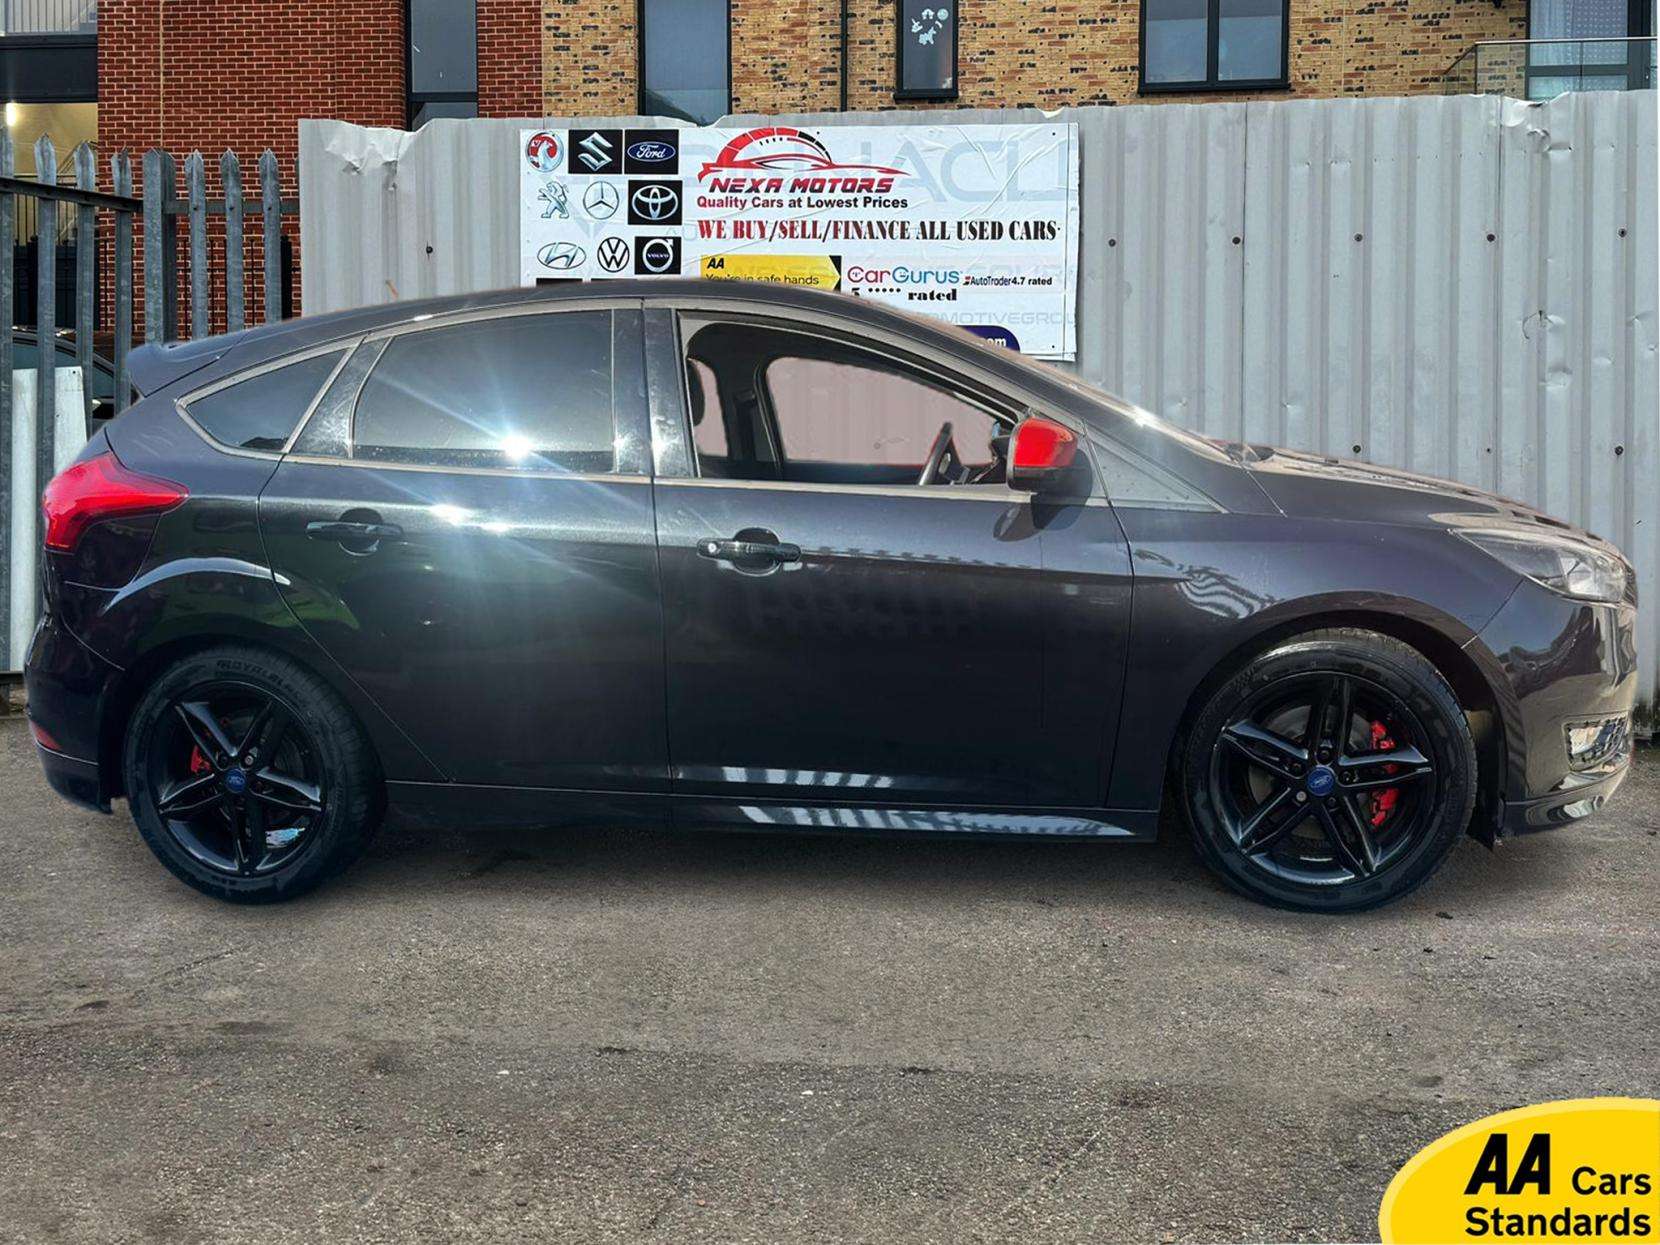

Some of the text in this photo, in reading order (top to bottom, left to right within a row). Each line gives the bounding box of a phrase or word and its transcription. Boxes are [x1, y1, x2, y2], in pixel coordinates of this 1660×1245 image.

[636, 143, 666, 159] Ford
[708, 177, 895, 194] NEXA MOTORS
[697, 195, 909, 211] Quality Cars at Lowest Prices
[698, 220, 727, 240] WE
[915, 220, 951, 240] ALL
[956, 220, 1004, 240] USED
[1008, 220, 1057, 240] CARS
[707, 257, 725, 269] AA
[757, 274, 781, 283] safe
[784, 274, 820, 285] hands
[847, 266, 960, 284] CarGurus
[1028, 276, 1053, 286] rated
[908, 288, 957, 301] rated
